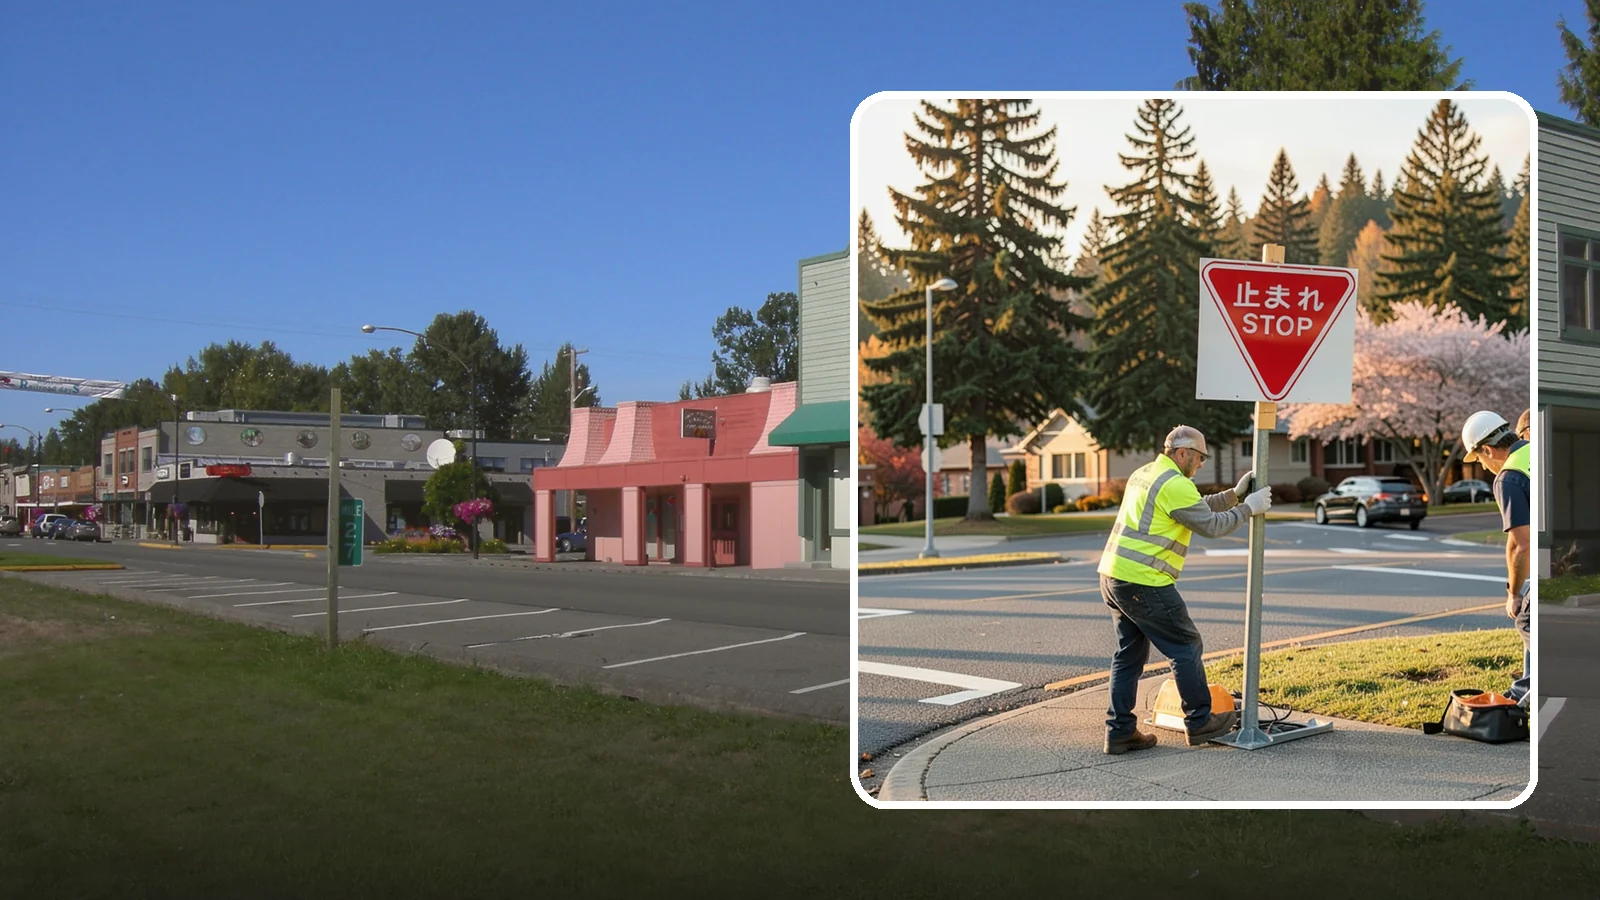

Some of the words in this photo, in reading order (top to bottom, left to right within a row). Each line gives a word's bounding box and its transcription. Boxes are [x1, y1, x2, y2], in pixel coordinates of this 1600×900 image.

[1233, 281, 1324, 312] 止まれ
[1242, 313, 1313, 337] STOP
[341, 505, 361, 516] MILE
[344, 522, 356, 539] 2
[344, 543, 356, 560] 7
